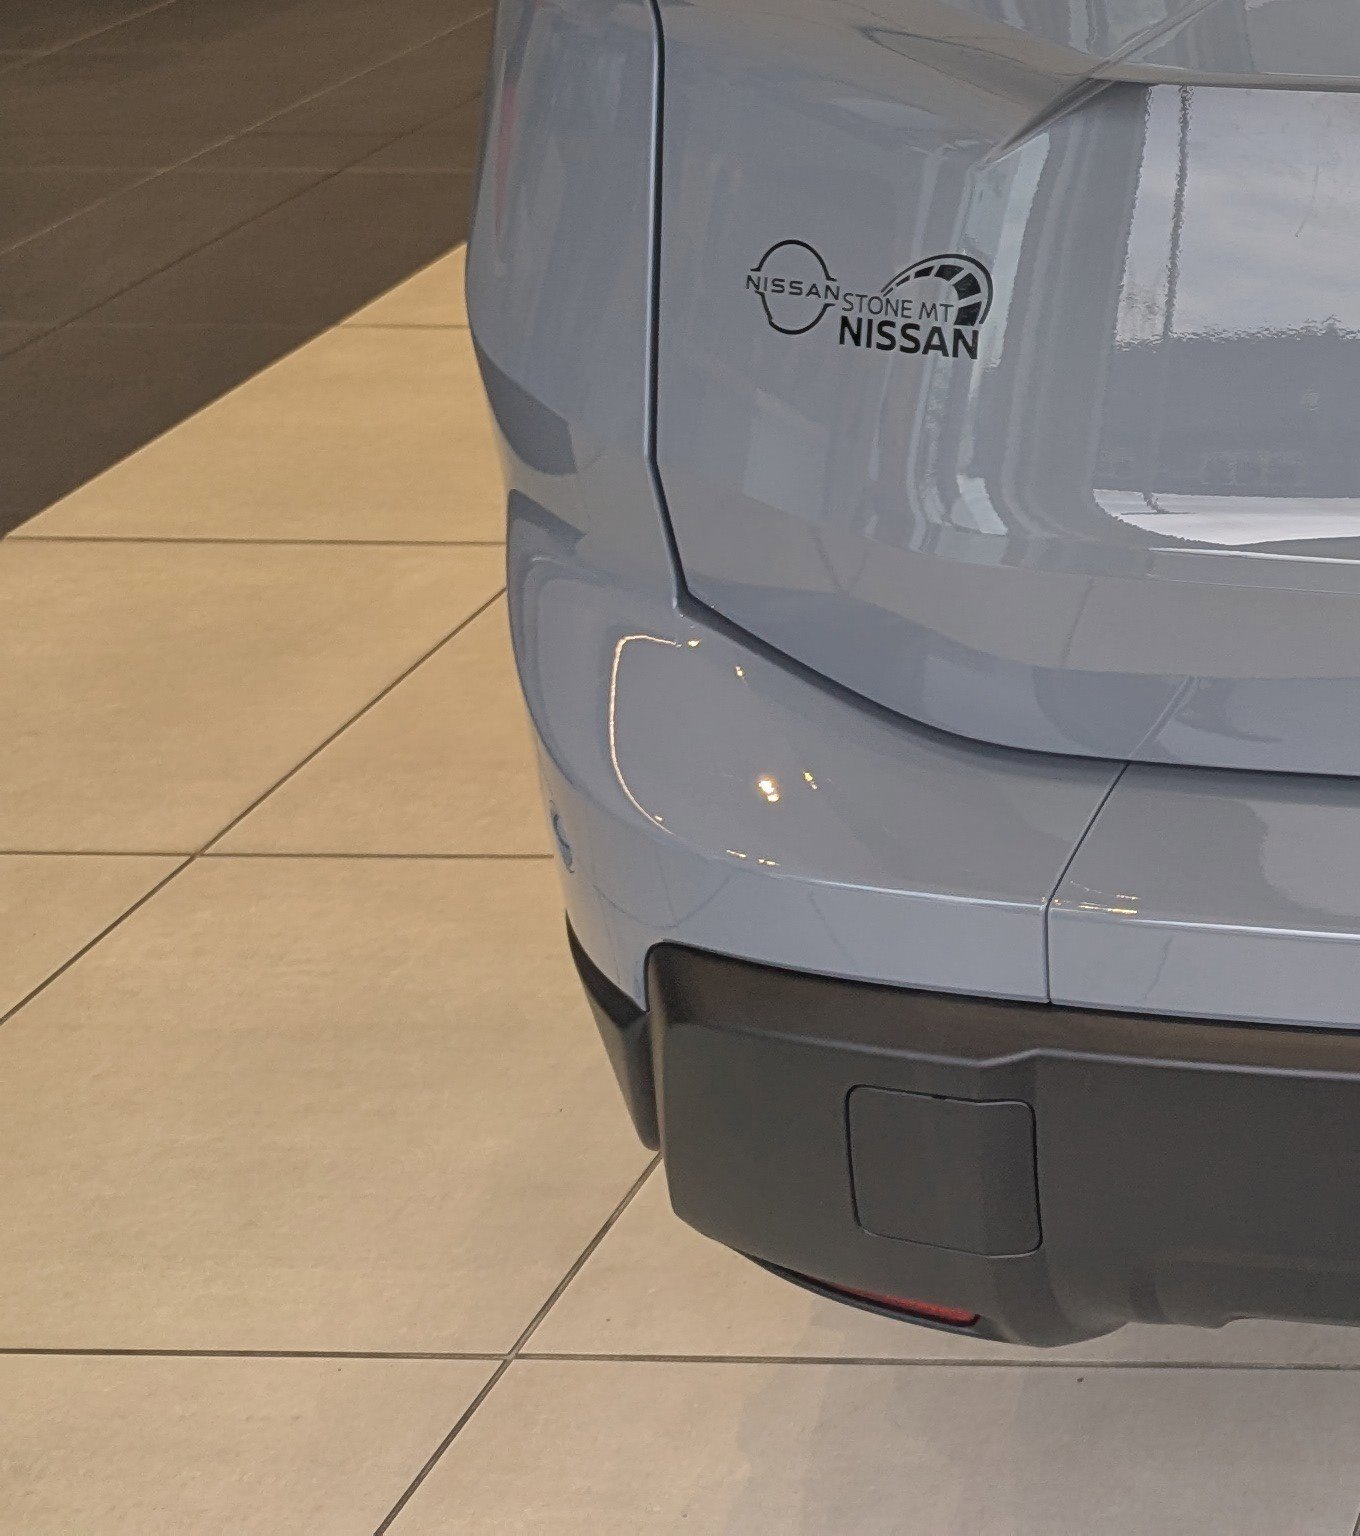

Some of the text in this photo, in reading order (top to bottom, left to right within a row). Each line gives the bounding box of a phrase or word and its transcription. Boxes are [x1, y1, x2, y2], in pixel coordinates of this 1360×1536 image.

[746, 273, 841, 301] NISSAN
[842, 291, 954, 322] STONE MT
[839, 315, 980, 360] NISSAN
